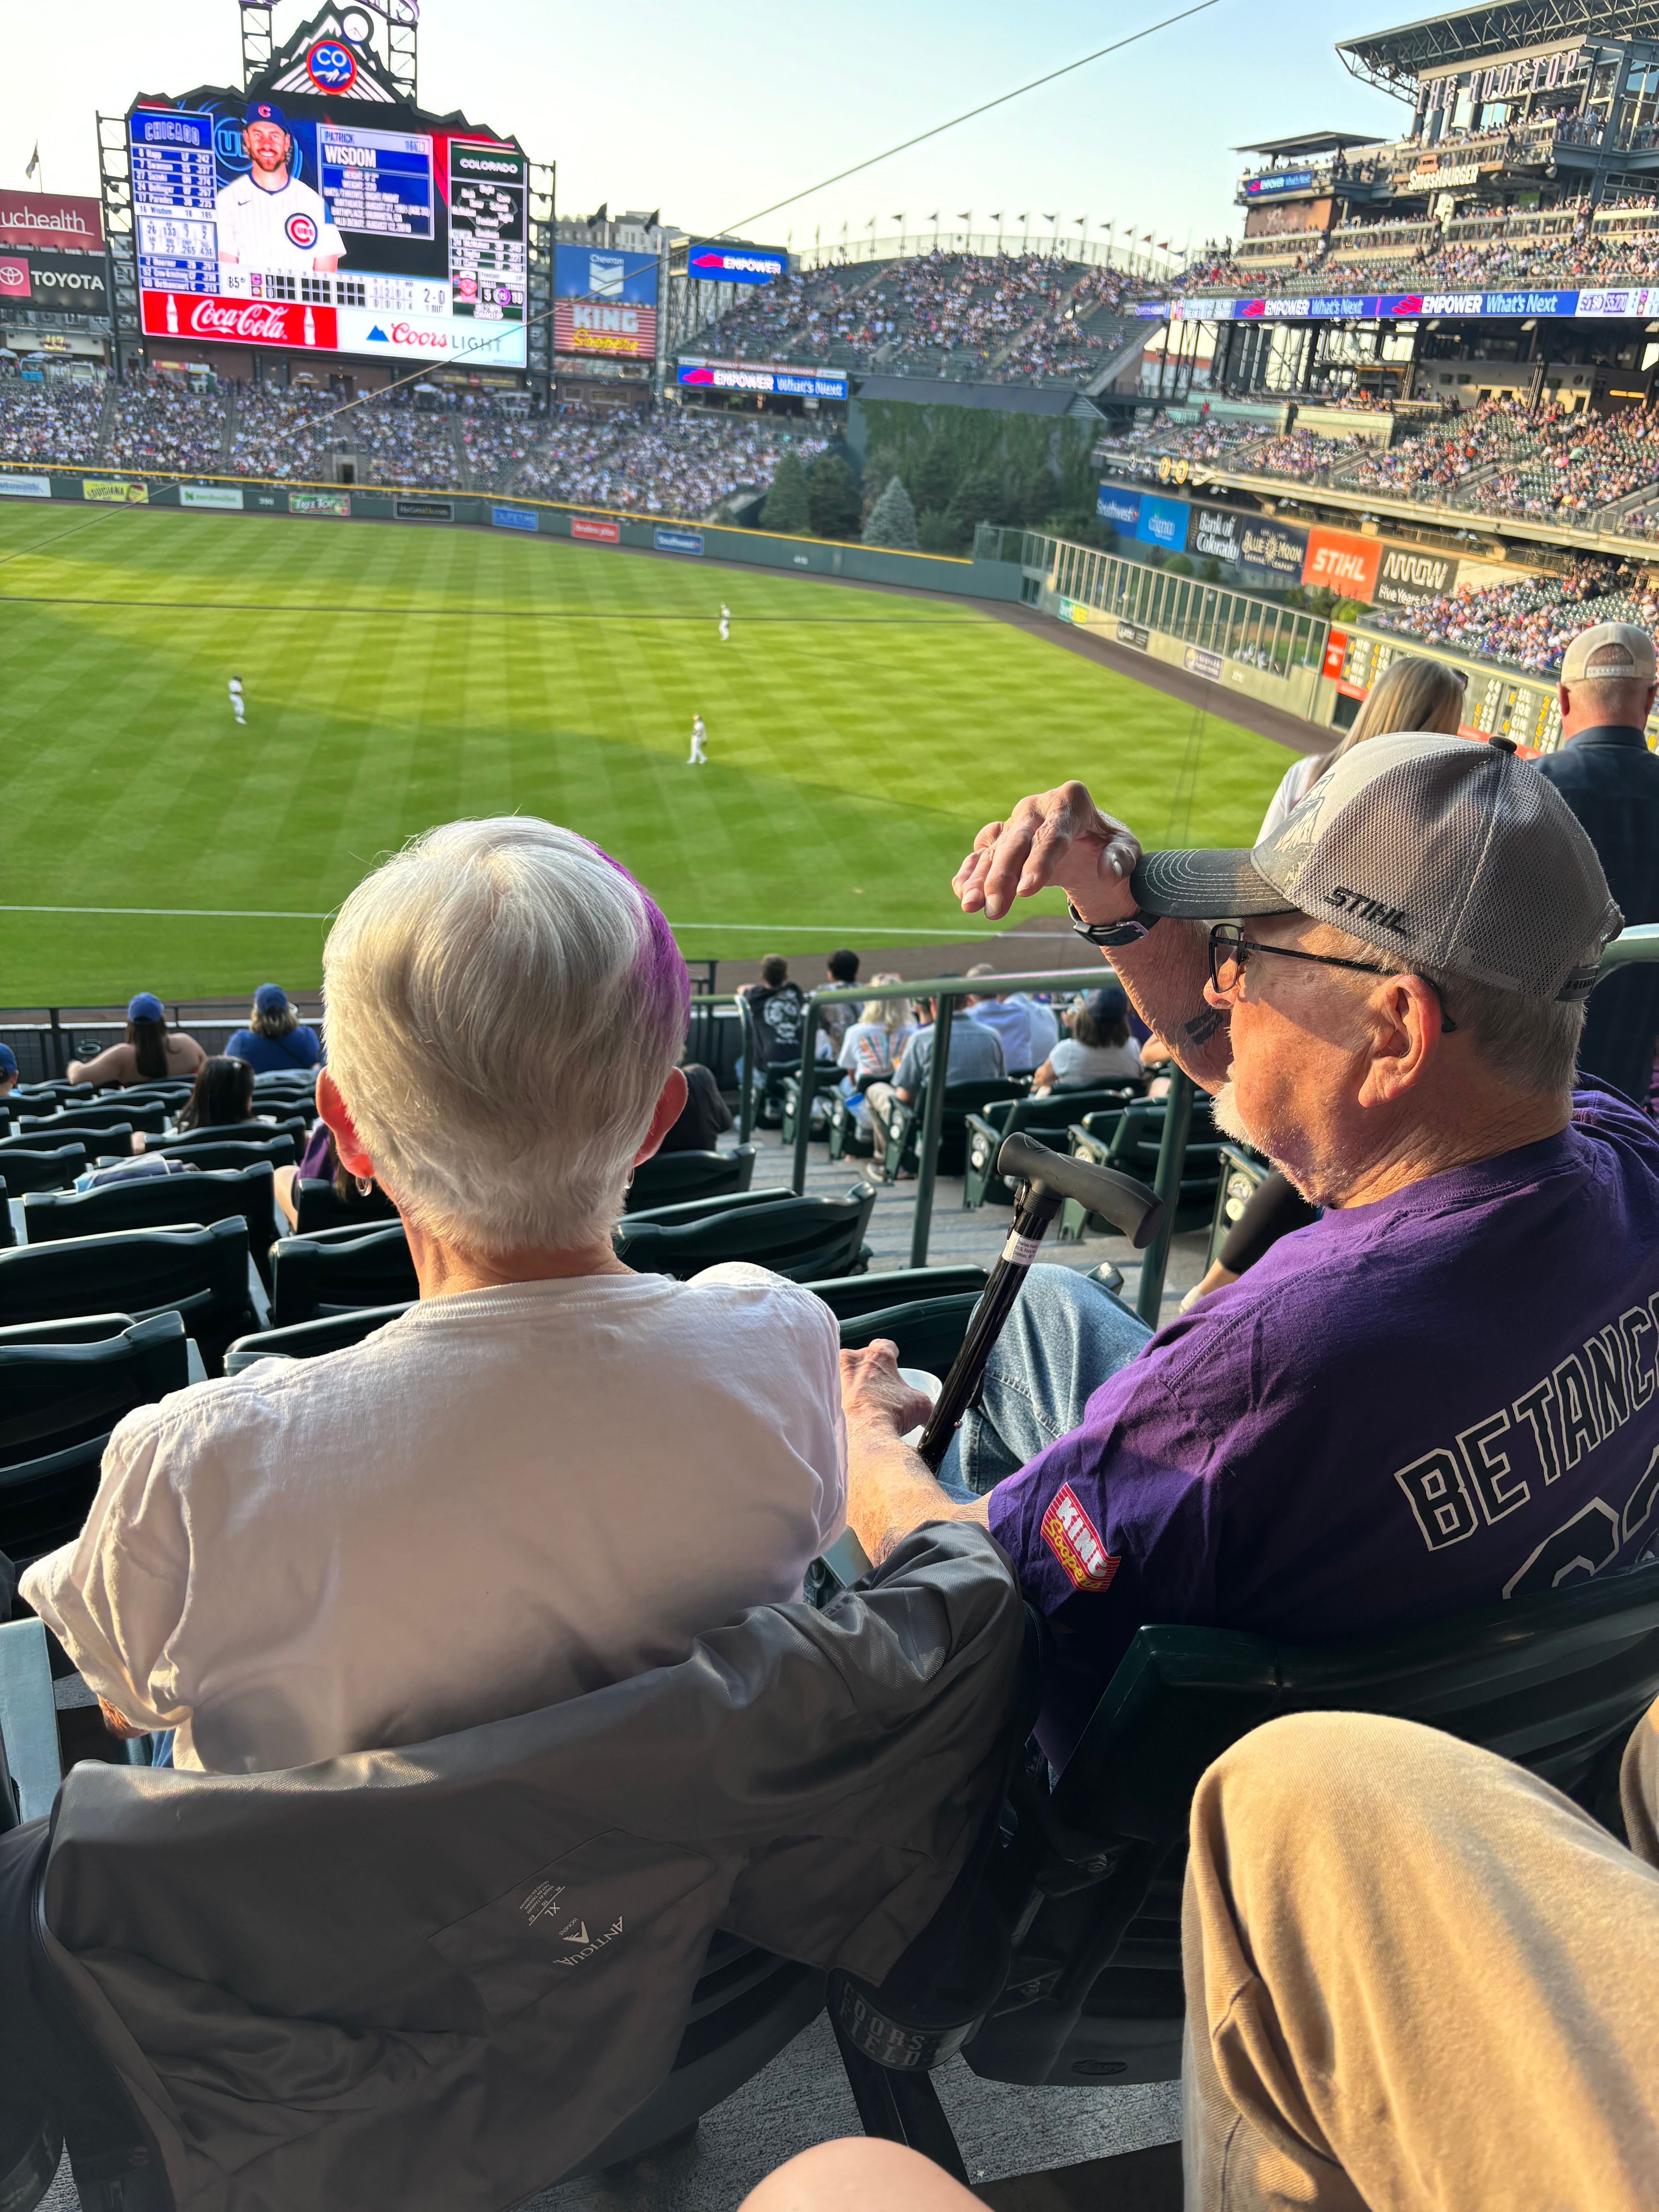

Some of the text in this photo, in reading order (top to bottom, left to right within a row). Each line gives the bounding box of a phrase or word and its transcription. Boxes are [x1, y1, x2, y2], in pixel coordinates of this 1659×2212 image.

[316, 48, 346, 67] CO
[1417, 48, 1580, 114] THE ROOFTOP
[144, 122, 199, 146] CHICAGO
[325, 131, 354, 144] PATRICK
[324, 144, 376, 168] WISDOM
[460, 158, 518, 173] COLORADO
[2, 206, 86, 232] uchealth
[589, 254, 624, 265] Chevron
[723, 255, 781, 274] EMPOWER
[31, 271, 105, 291] TOYOTA
[1264, 298, 1364, 316] EMPOWER What's Next
[1421, 295, 1483, 313] EMPOWER
[1487, 294, 1525, 313] What's
[1526, 294, 1558, 313] Next
[191, 299, 289, 340] Coca-Cola
[572, 305, 639, 333] KING
[391, 323, 502, 352] Coors LIGHT
[714, 371, 774, 390] EMPOWER
[1096, 497, 1134, 522] Southwest
[1199, 510, 1237, 538] Bank of
[1196, 531, 1240, 559] Colorado
[1242, 529, 1265, 553] BLUE
[1278, 541, 1304, 563] MOON
[1312, 547, 1366, 582] STIHL
[1323, 886, 1406, 936] STIHL
[1056, 1496, 1108, 1577] KING
[544, 1902, 560, 1916] XL
[559, 1917, 578, 1936] WOMENS
[556, 1915, 623, 1966] ANTIGUA
[843, 1981, 925, 2050] COORS
[841, 2001, 921, 2066] FIELD
